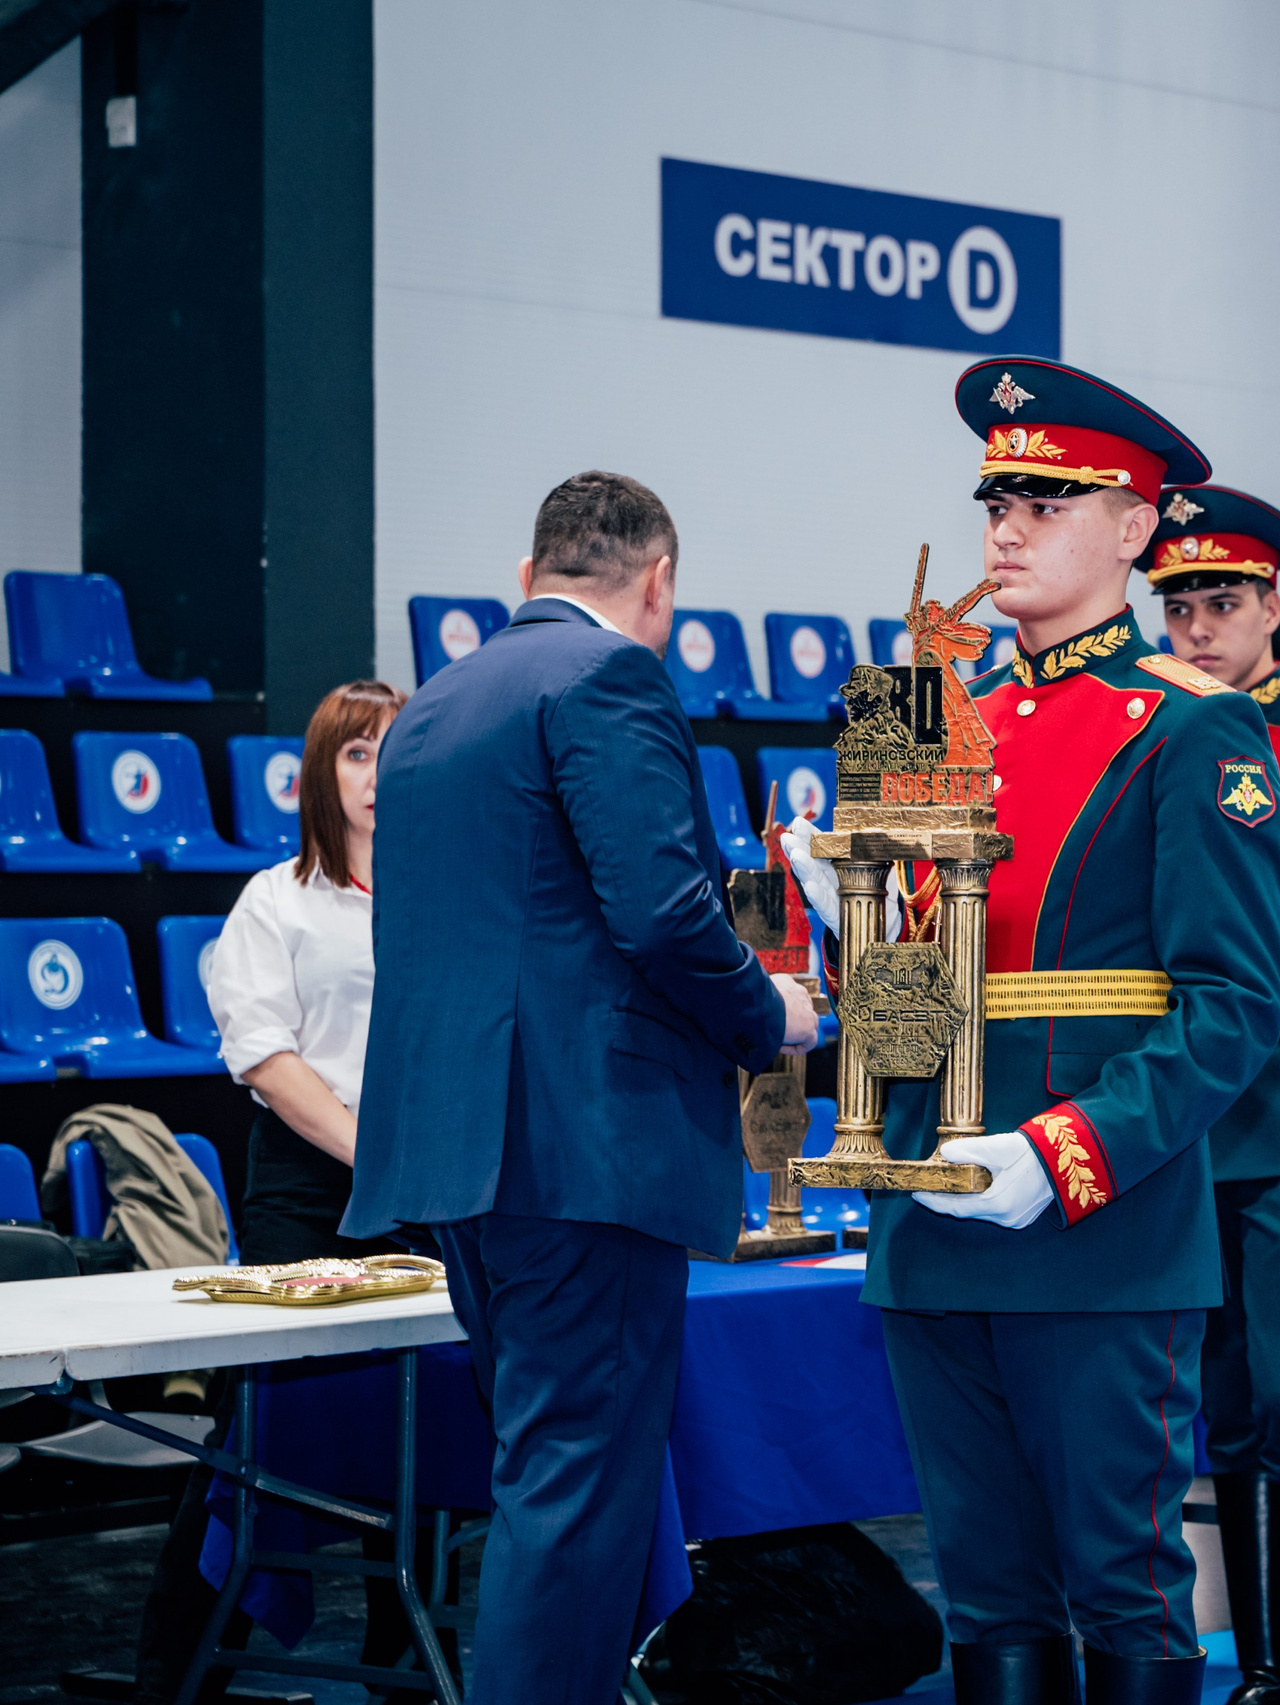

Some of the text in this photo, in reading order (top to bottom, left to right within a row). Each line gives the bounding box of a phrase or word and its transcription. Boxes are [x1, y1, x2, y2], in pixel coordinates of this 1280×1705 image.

[714, 213, 941, 300] СЕКТОР
[839, 746, 944, 761] ЖИРИНОВСКИЙ
[1225, 764, 1262, 774] РОССИЯ
[881, 772, 994, 806] ПОБЕДА!
